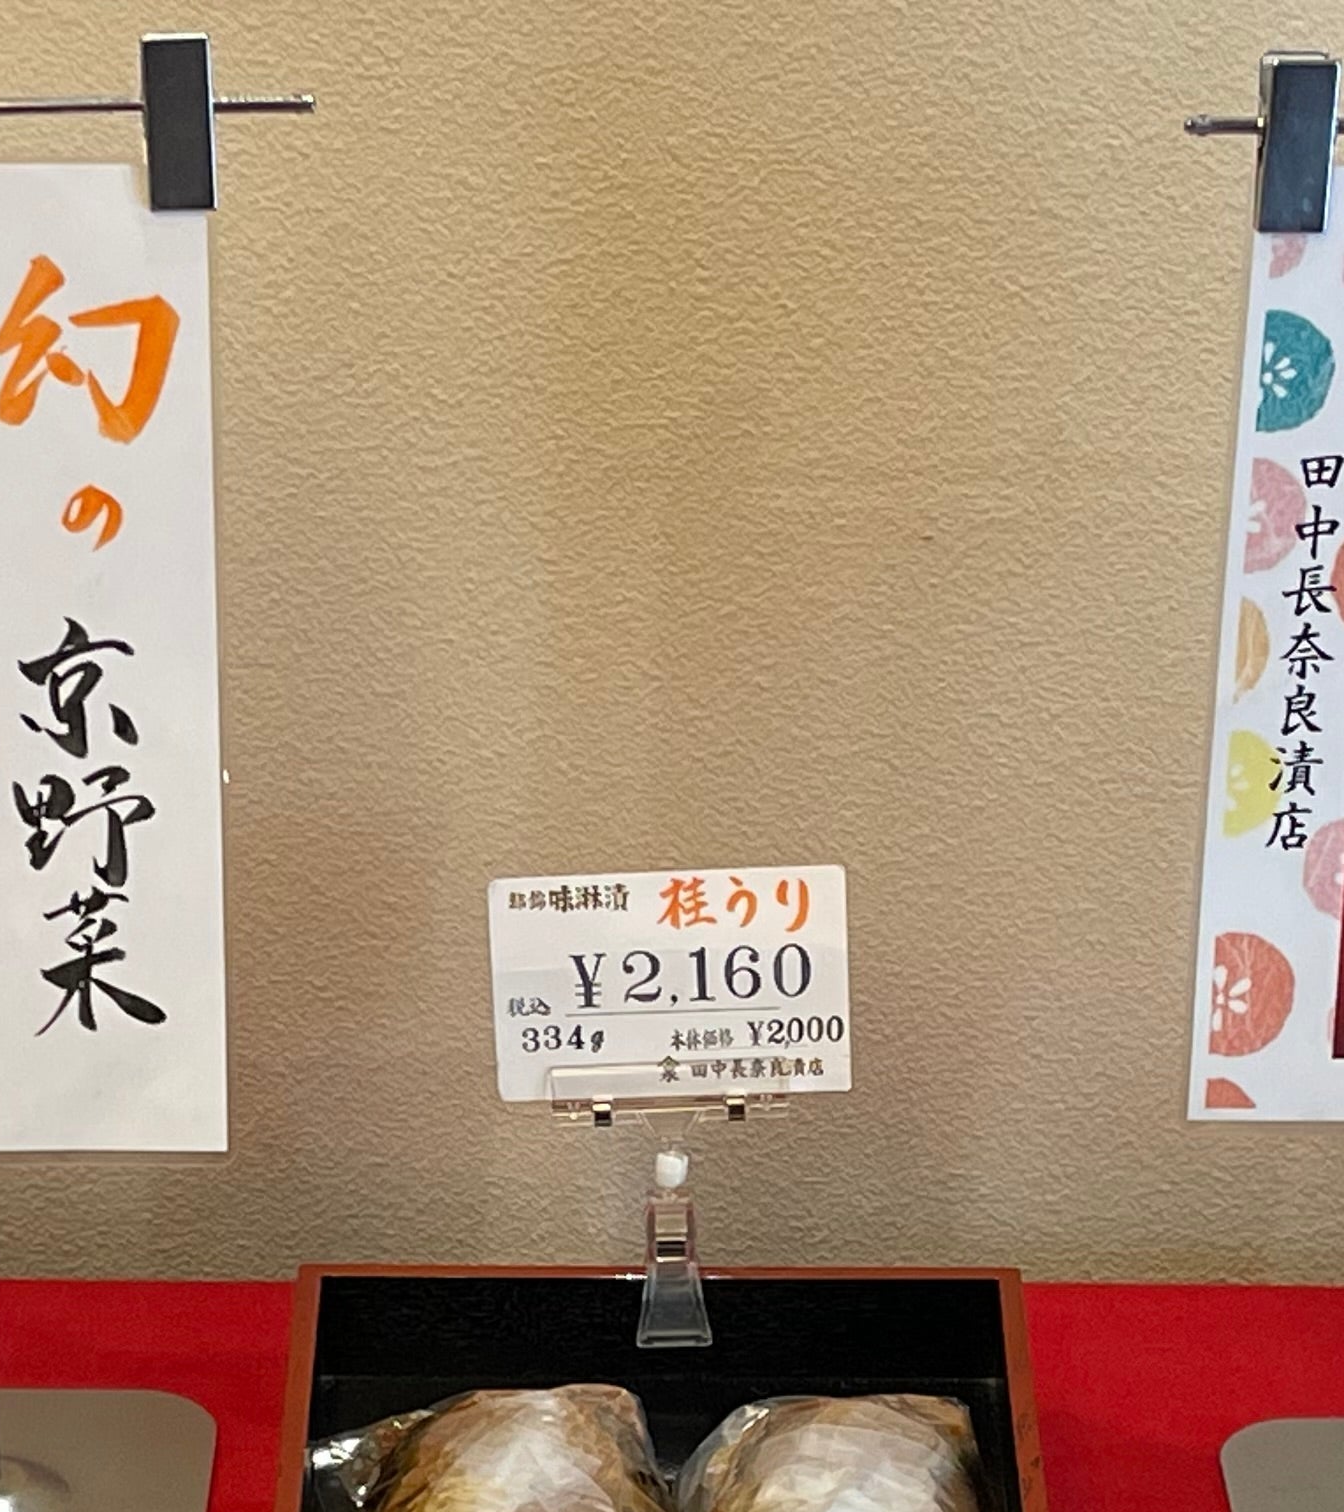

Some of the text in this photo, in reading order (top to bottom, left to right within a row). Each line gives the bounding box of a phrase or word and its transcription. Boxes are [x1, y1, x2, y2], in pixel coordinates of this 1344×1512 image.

[1265, 452, 1344, 853] 田中長奈良漬店
[656, 875, 811, 933] 桂うり
[506, 942, 812, 1018] 税込 ¥2,160
[521, 1024, 605, 1053] 334g
